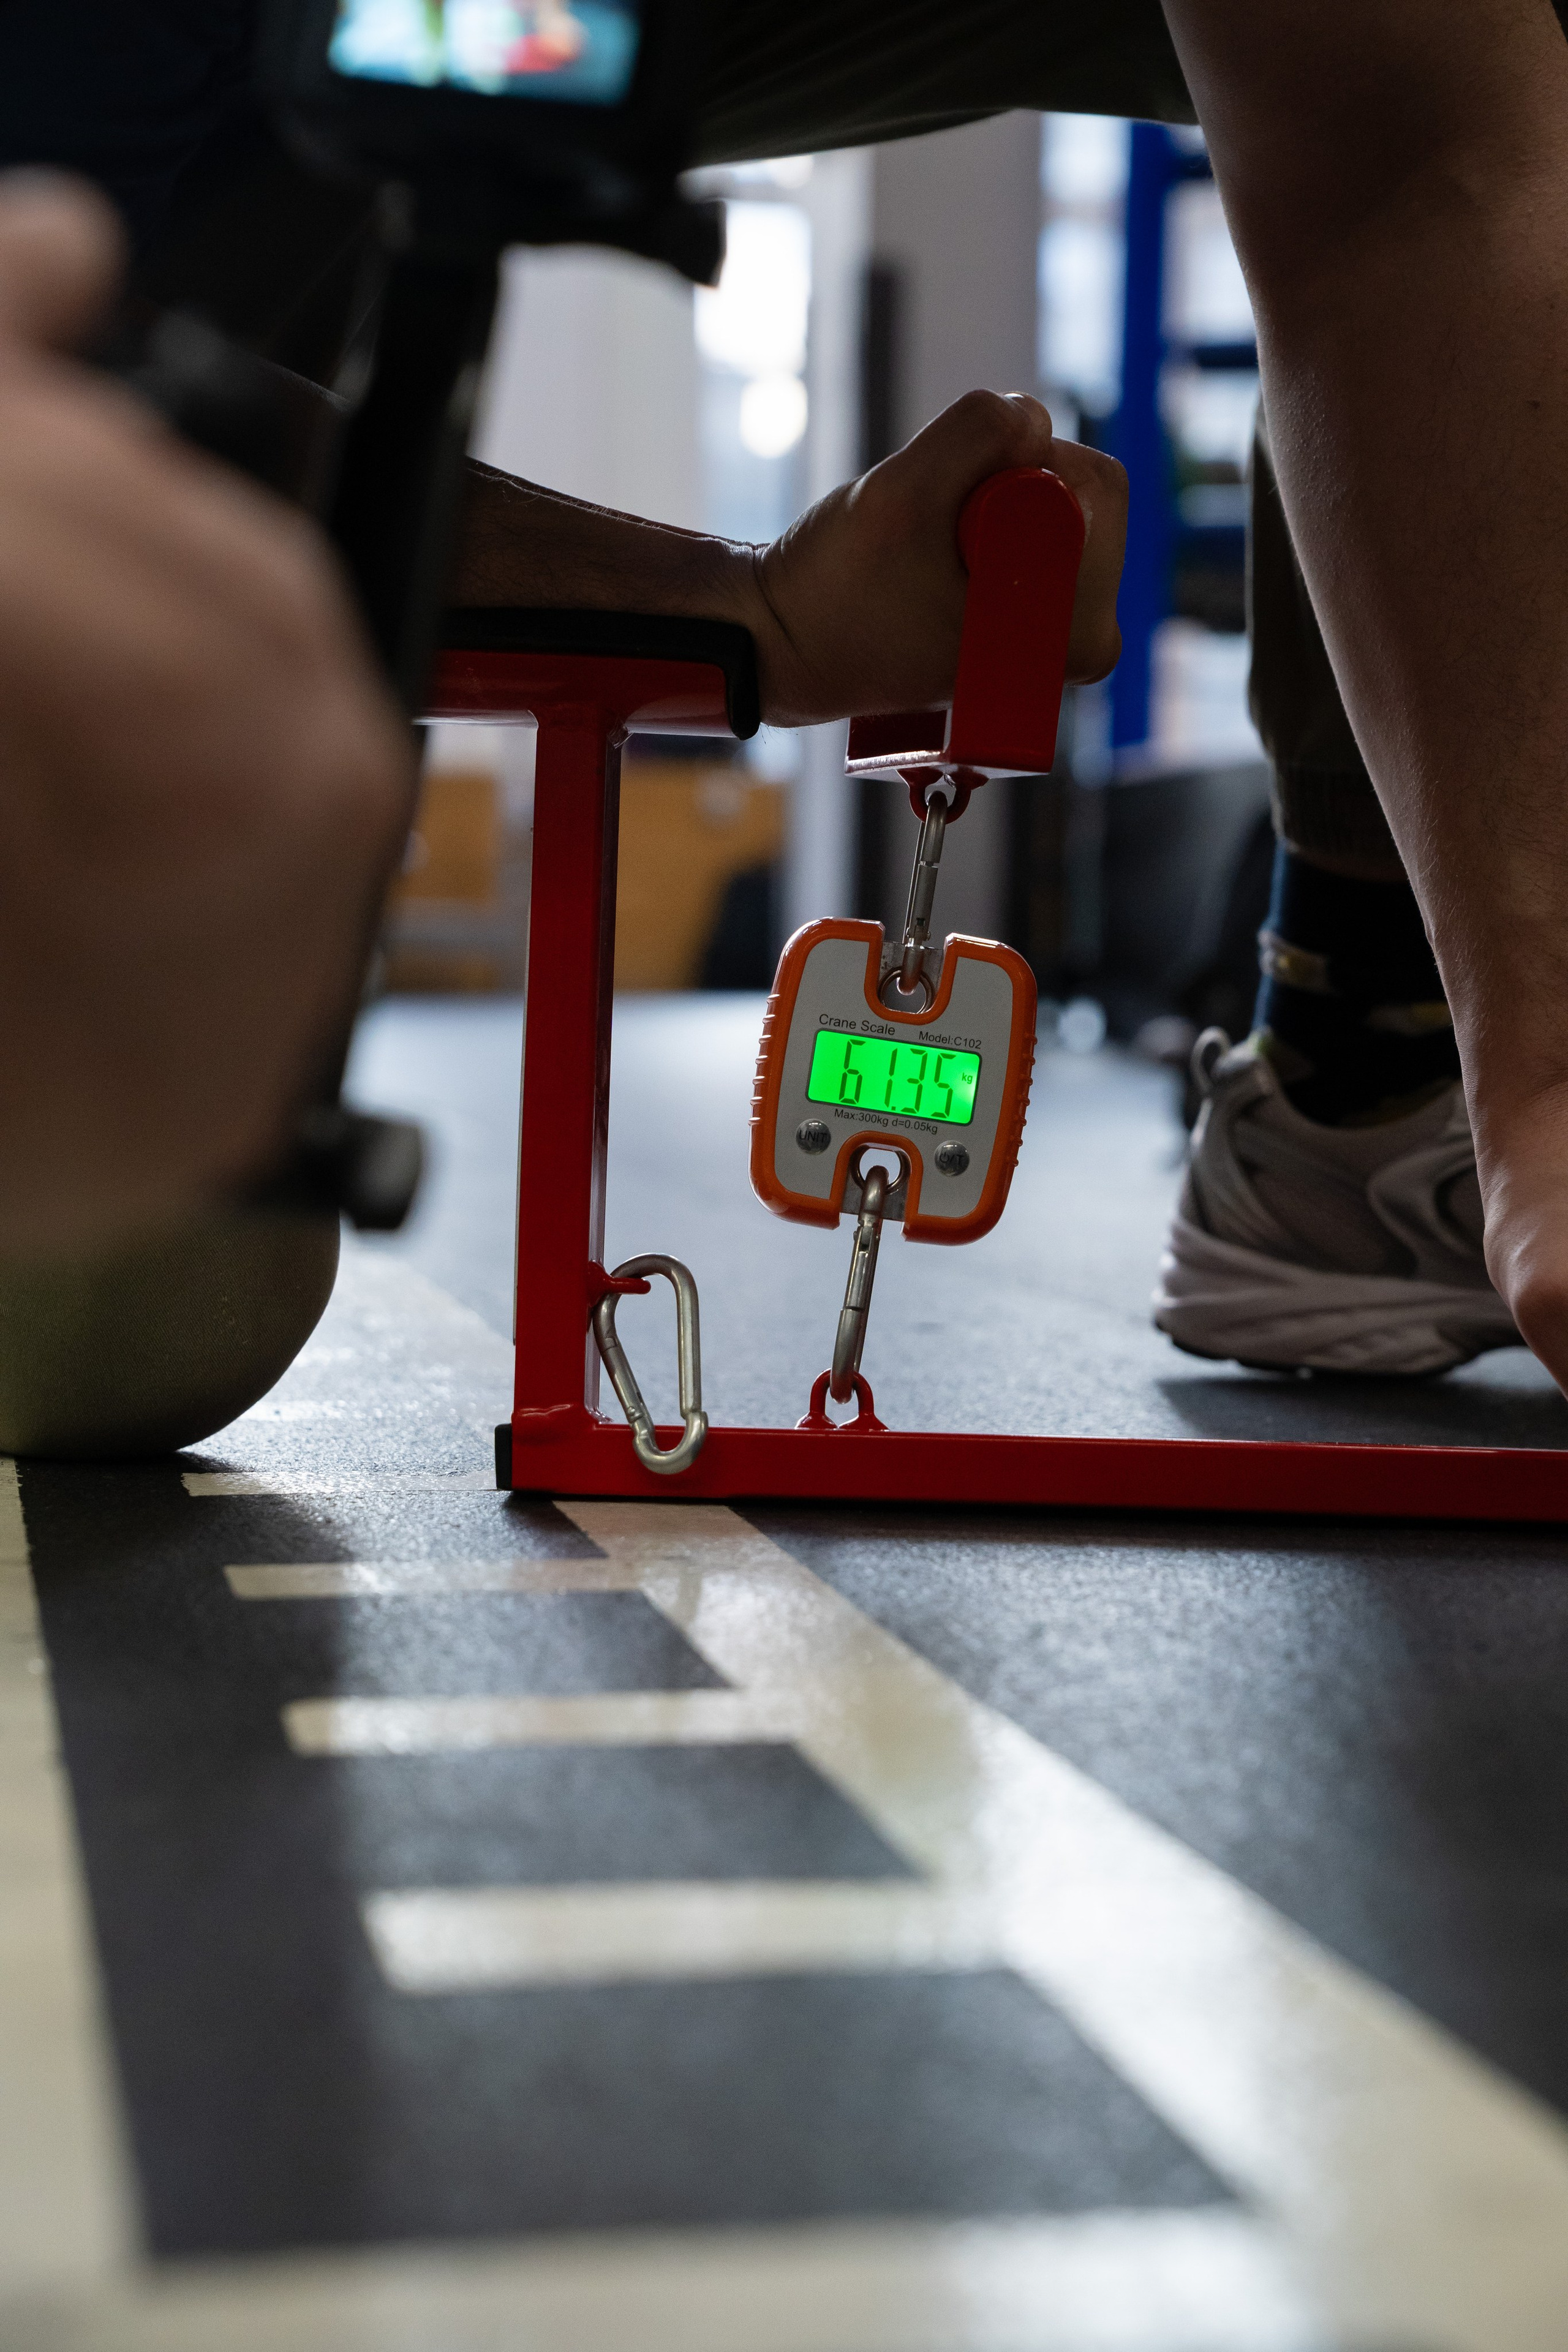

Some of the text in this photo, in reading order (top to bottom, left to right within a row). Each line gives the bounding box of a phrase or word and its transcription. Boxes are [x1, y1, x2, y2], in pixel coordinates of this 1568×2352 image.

[819, 1014, 895, 1036] Crane Scale
[919, 1031, 982, 1049] Model:C102
[839, 1039, 973, 1119] 61.35 kg
[834, 1108, 938, 1134] Max:300kg d=0.05kg
[799, 1129, 827, 1144] UNIT
